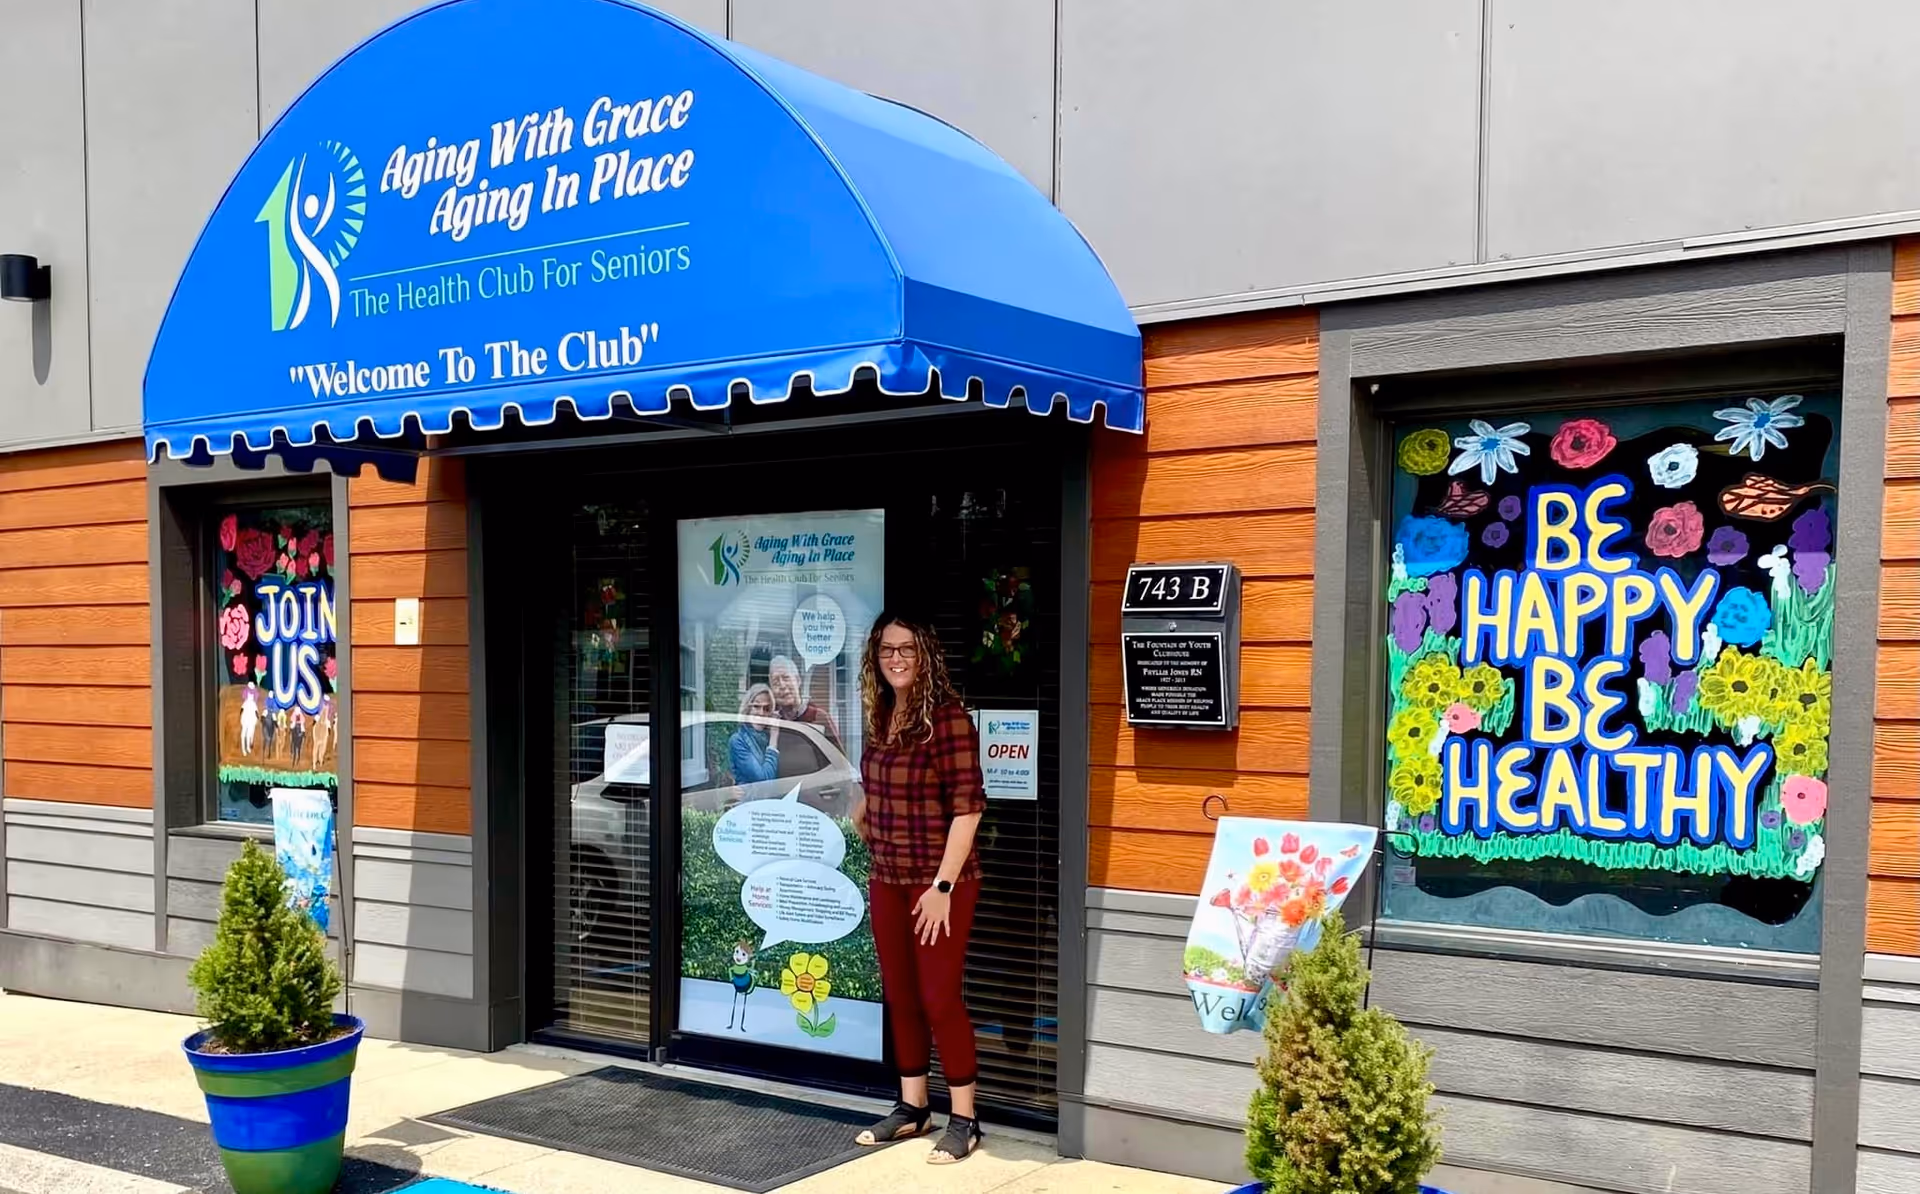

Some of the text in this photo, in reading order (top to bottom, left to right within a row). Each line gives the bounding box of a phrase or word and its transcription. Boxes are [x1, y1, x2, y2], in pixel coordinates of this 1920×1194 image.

[380, 89, 694, 199] Aging With Grace
[429, 149, 694, 242] Aging In Place
[349, 245, 690, 317] The Health Club For Seniors
[289, 322, 659, 399] "Welcome To The Club"
[754, 533, 855, 552] Aging With Grace
[772, 548, 855, 566] Aging In Place
[1532, 480, 1635, 575] BE
[256, 584, 336, 640] JOIN
[802, 611, 835, 622] We help
[1138, 576, 1210, 600] 743 B
[1465, 570, 1717, 663] HAPPY
[803, 622, 834, 633] you live
[807, 633, 831, 641] better
[272, 641, 322, 714] US
[1528, 656, 1634, 753] BE
[988, 744, 1029, 759] OPEN
[1446, 740, 1770, 841] HEALTHY
[1190, 989, 1246, 1022] Wel
